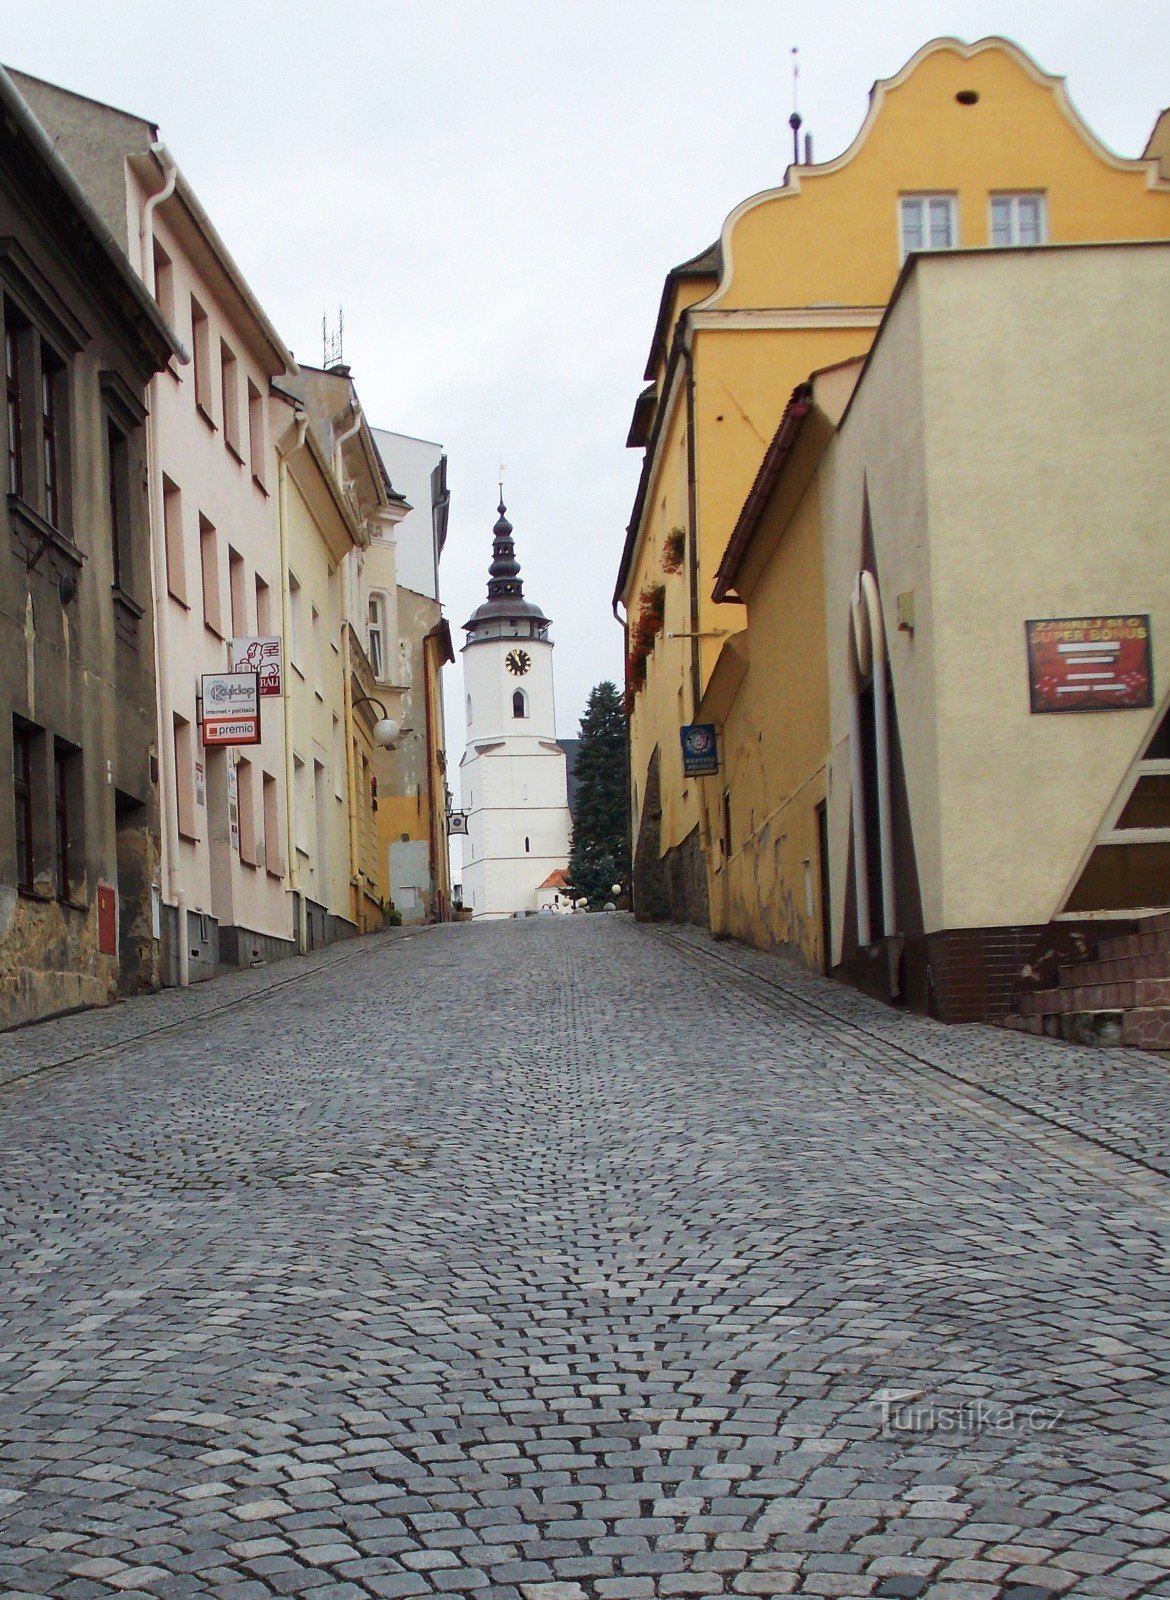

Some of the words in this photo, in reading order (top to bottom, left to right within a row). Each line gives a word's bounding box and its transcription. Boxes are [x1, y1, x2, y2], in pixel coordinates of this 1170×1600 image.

[1031, 630, 1085, 643] SUPER
[1089, 627, 1148, 640] BONUS
[260, 678, 279, 687] RALI
[219, 723, 254, 735] premio
